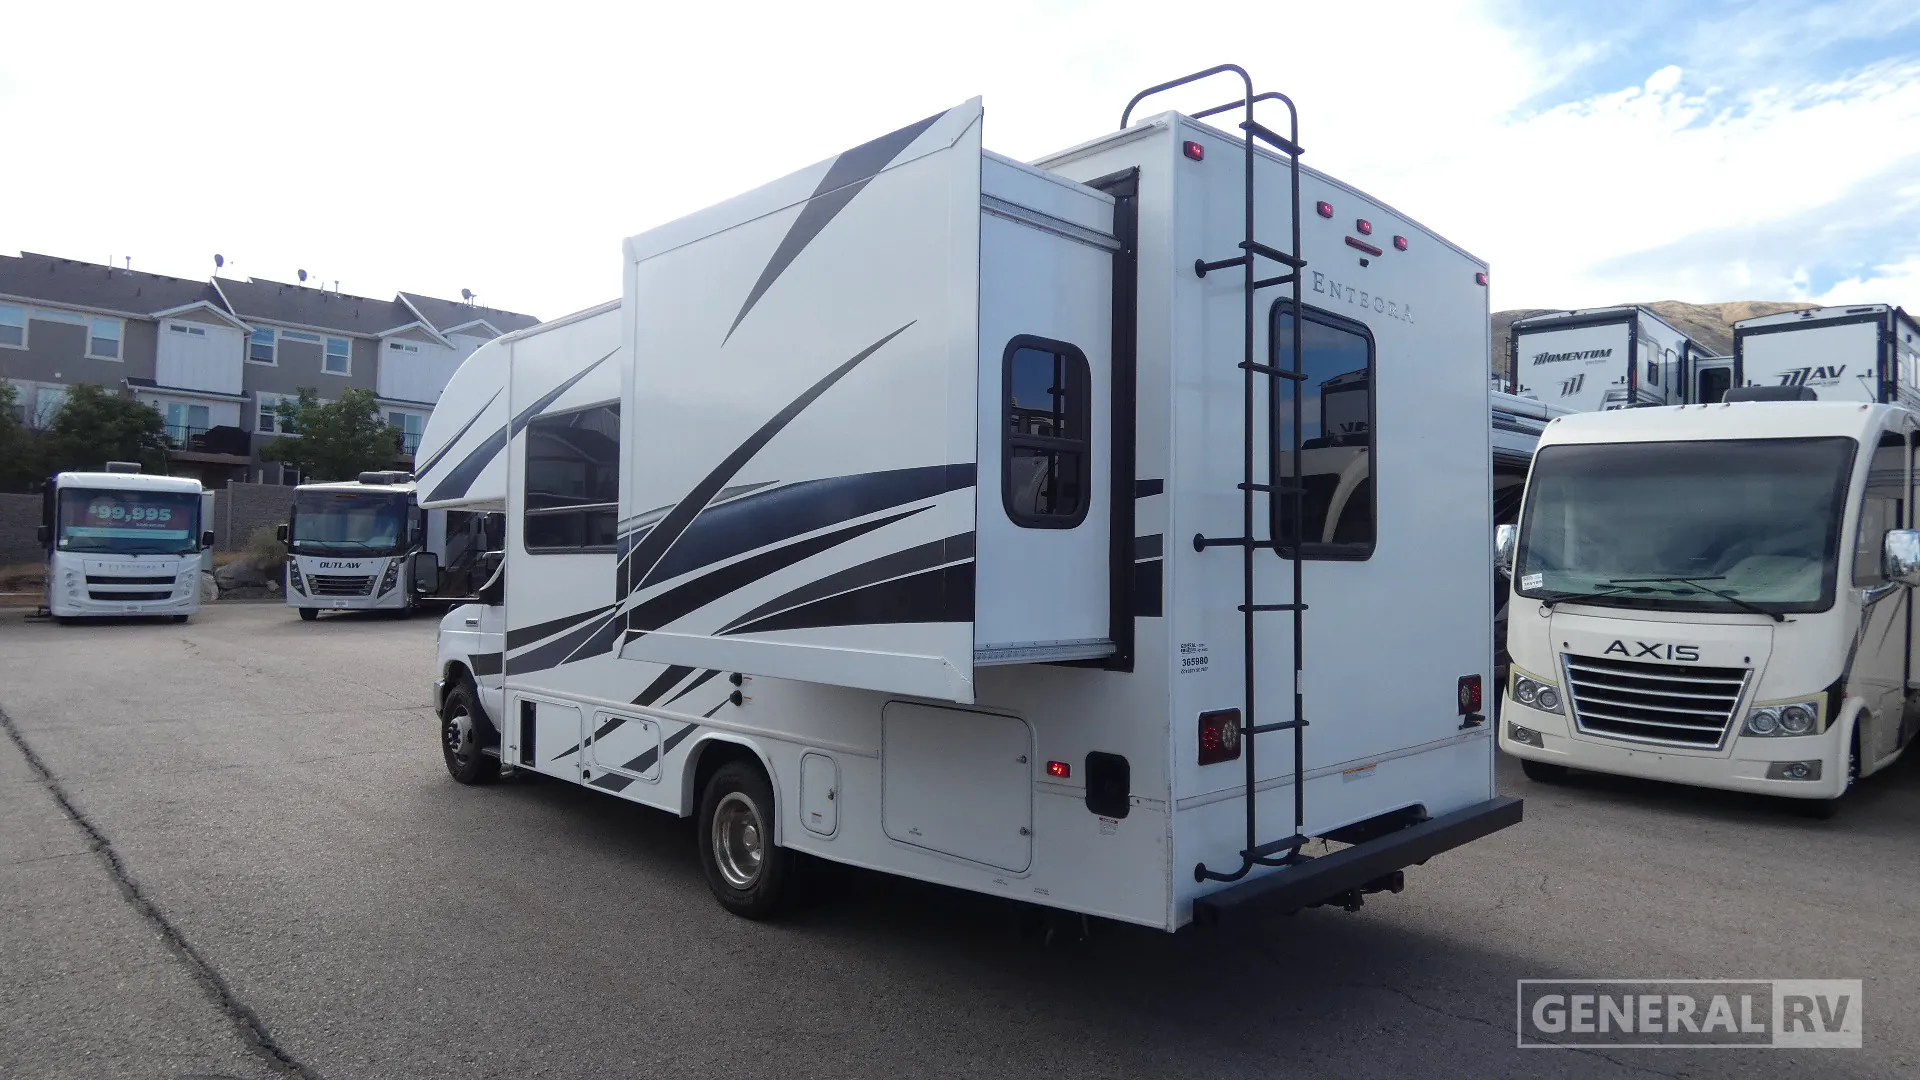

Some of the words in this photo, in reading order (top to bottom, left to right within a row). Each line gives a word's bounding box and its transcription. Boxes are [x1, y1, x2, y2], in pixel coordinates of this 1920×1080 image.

[1312, 270, 1414, 324] ENTEGRA
[1532, 348, 1613, 367] MOMENTUM
[319, 561, 362, 569] OUTLAW
[1603, 640, 1700, 662] AXIS
